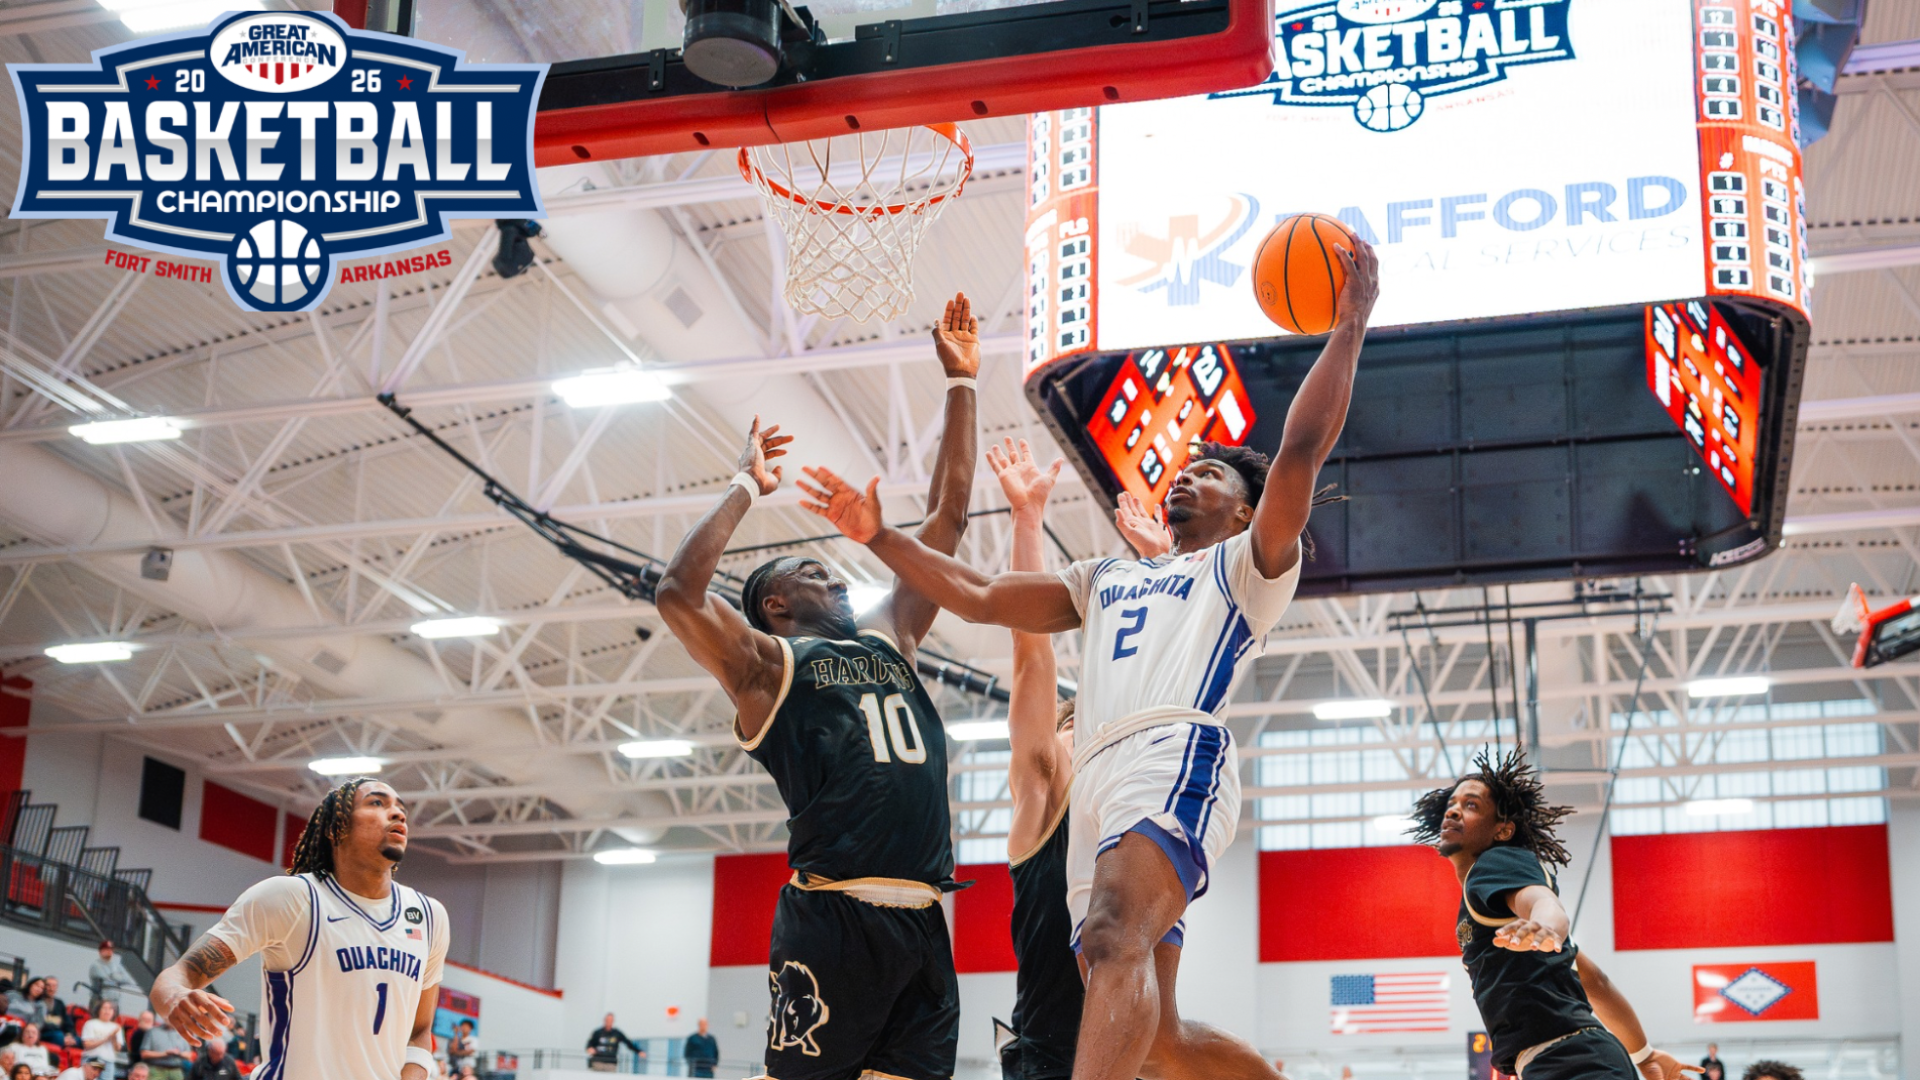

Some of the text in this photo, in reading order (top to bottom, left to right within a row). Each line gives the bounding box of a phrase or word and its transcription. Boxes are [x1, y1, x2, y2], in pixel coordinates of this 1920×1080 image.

[1273, 6, 1560, 81] ASKETBALL
[1300, 60, 1479, 94] CHAMPIONSHIP
[1275, 175, 1687, 245] AFFORD
[1480, 225, 1690, 267] SERVICES
[1100, 574, 1195, 610] OUACHITA
[1112, 606, 1148, 662] 2
[858, 692, 927, 765] 10
[406, 910, 420, 921] BV
[336, 945, 422, 982] OUACHITA
[373, 982, 388, 1035] 1
